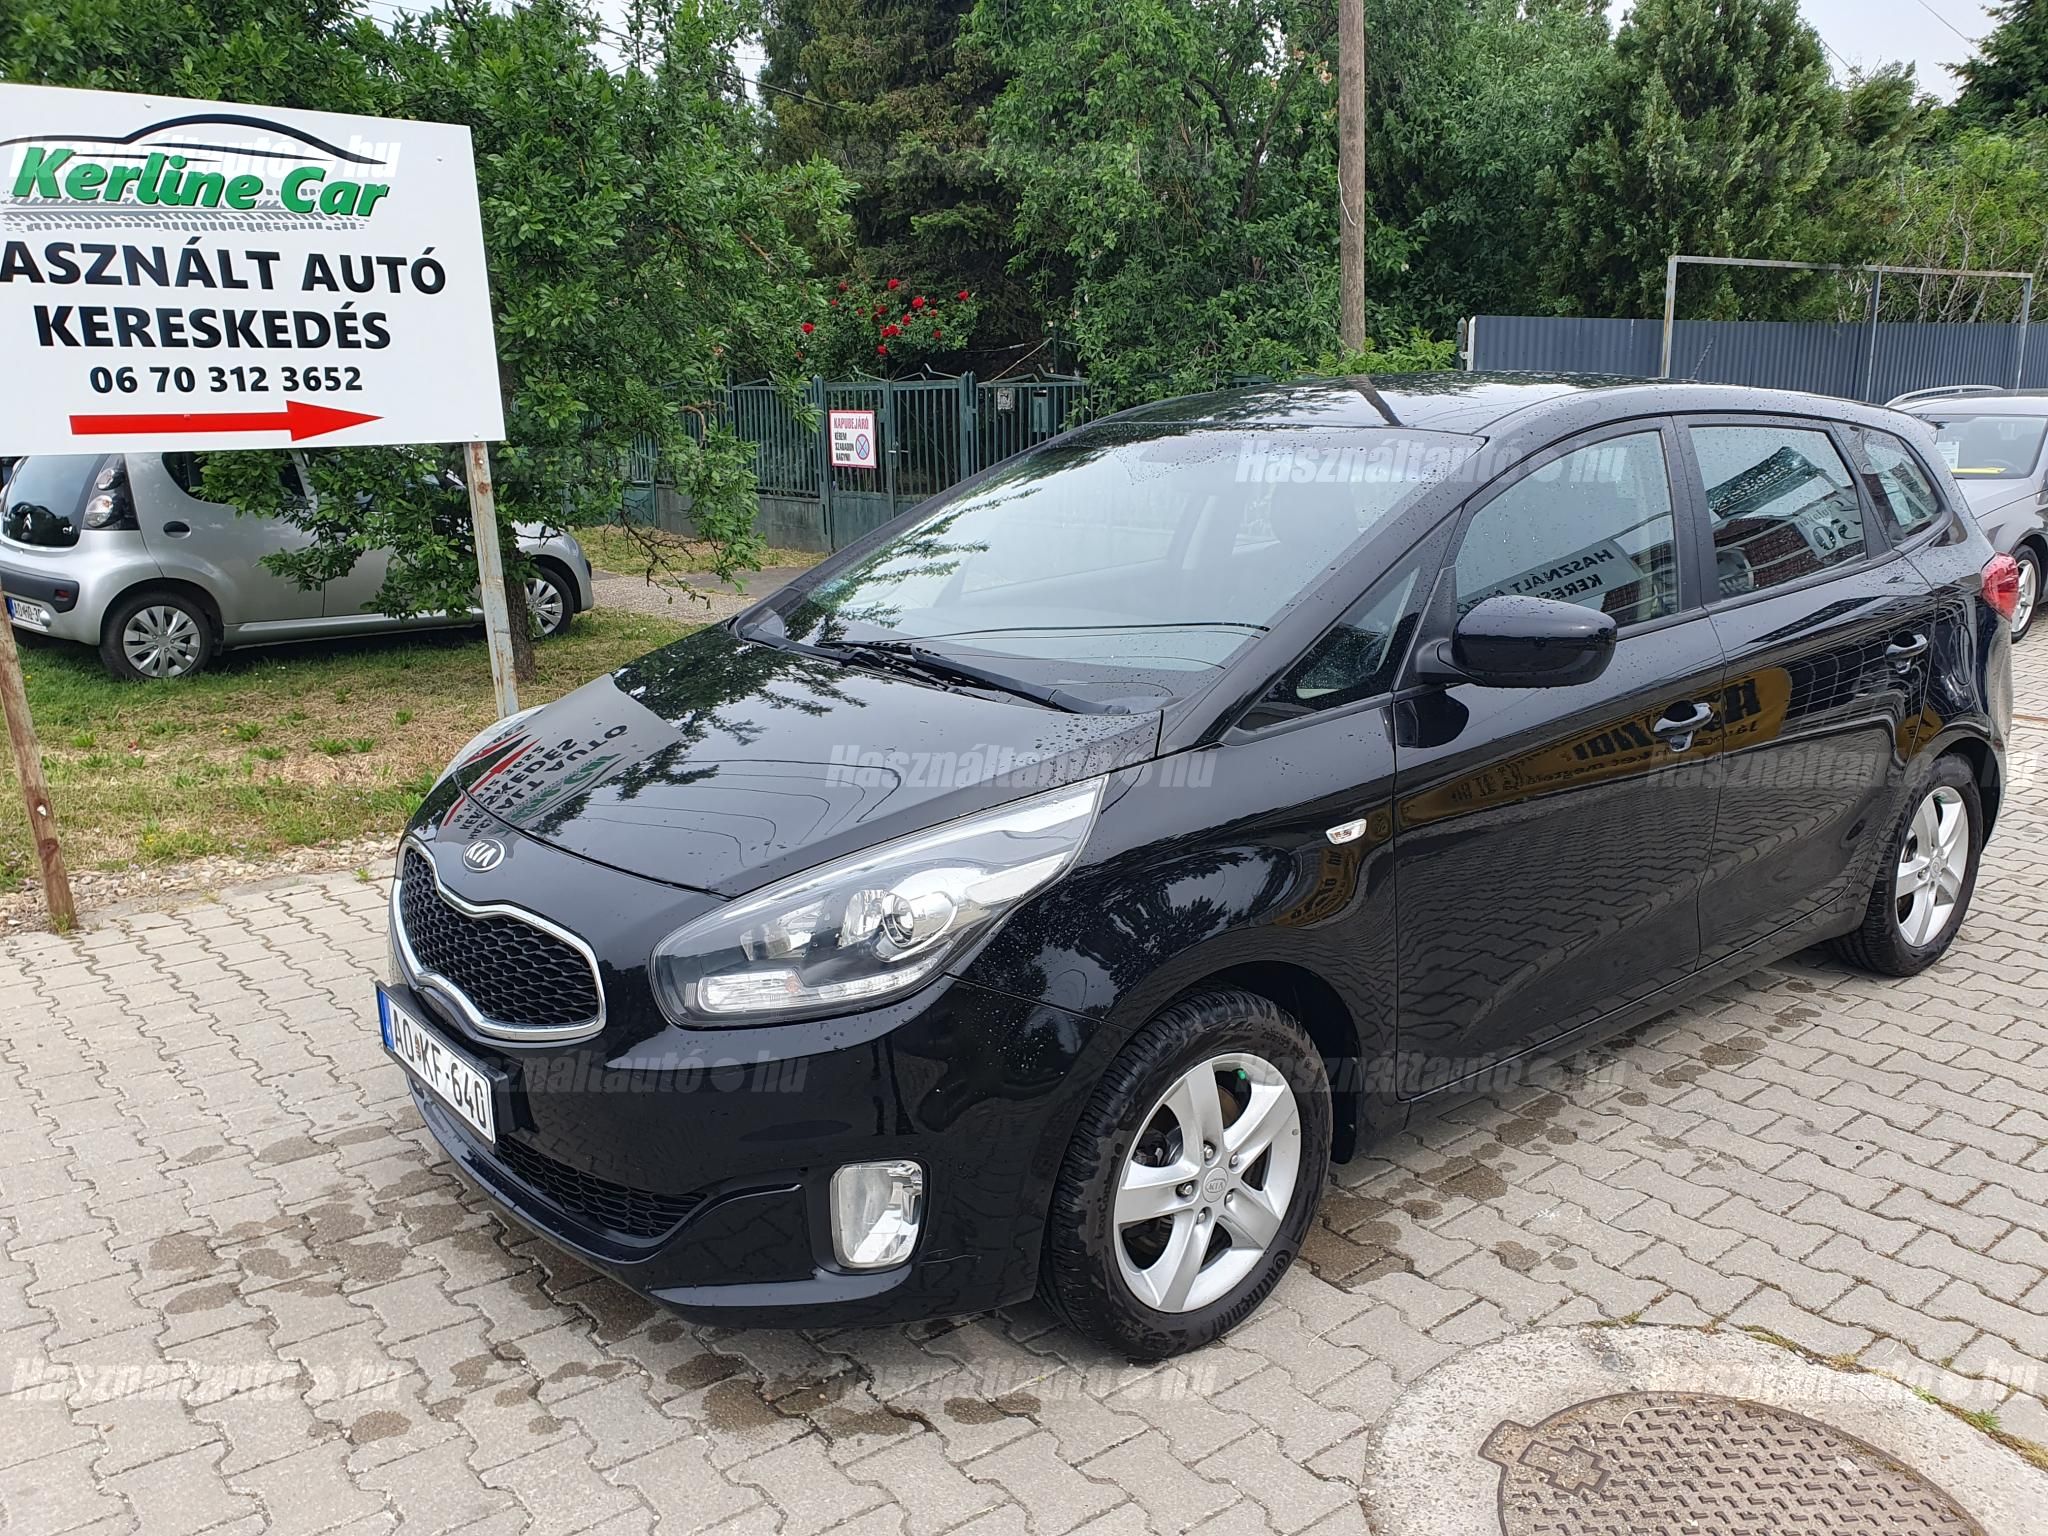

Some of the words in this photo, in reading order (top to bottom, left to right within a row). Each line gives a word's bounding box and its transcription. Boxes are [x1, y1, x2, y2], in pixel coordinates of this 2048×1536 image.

[12, 147, 266, 210] Kerline
[281, 166, 389, 216] Car
[301, 246, 446, 295] AUTÓ
[33, 302, 392, 350] KERESKEDÉS
[89, 366, 138, 393] 06
[149, 366, 196, 393] 70
[208, 366, 269, 392] 312
[281, 366, 363, 392] 3652
[465, 841, 497, 867] KIA
[419, 1033, 487, 1129] KF-640
